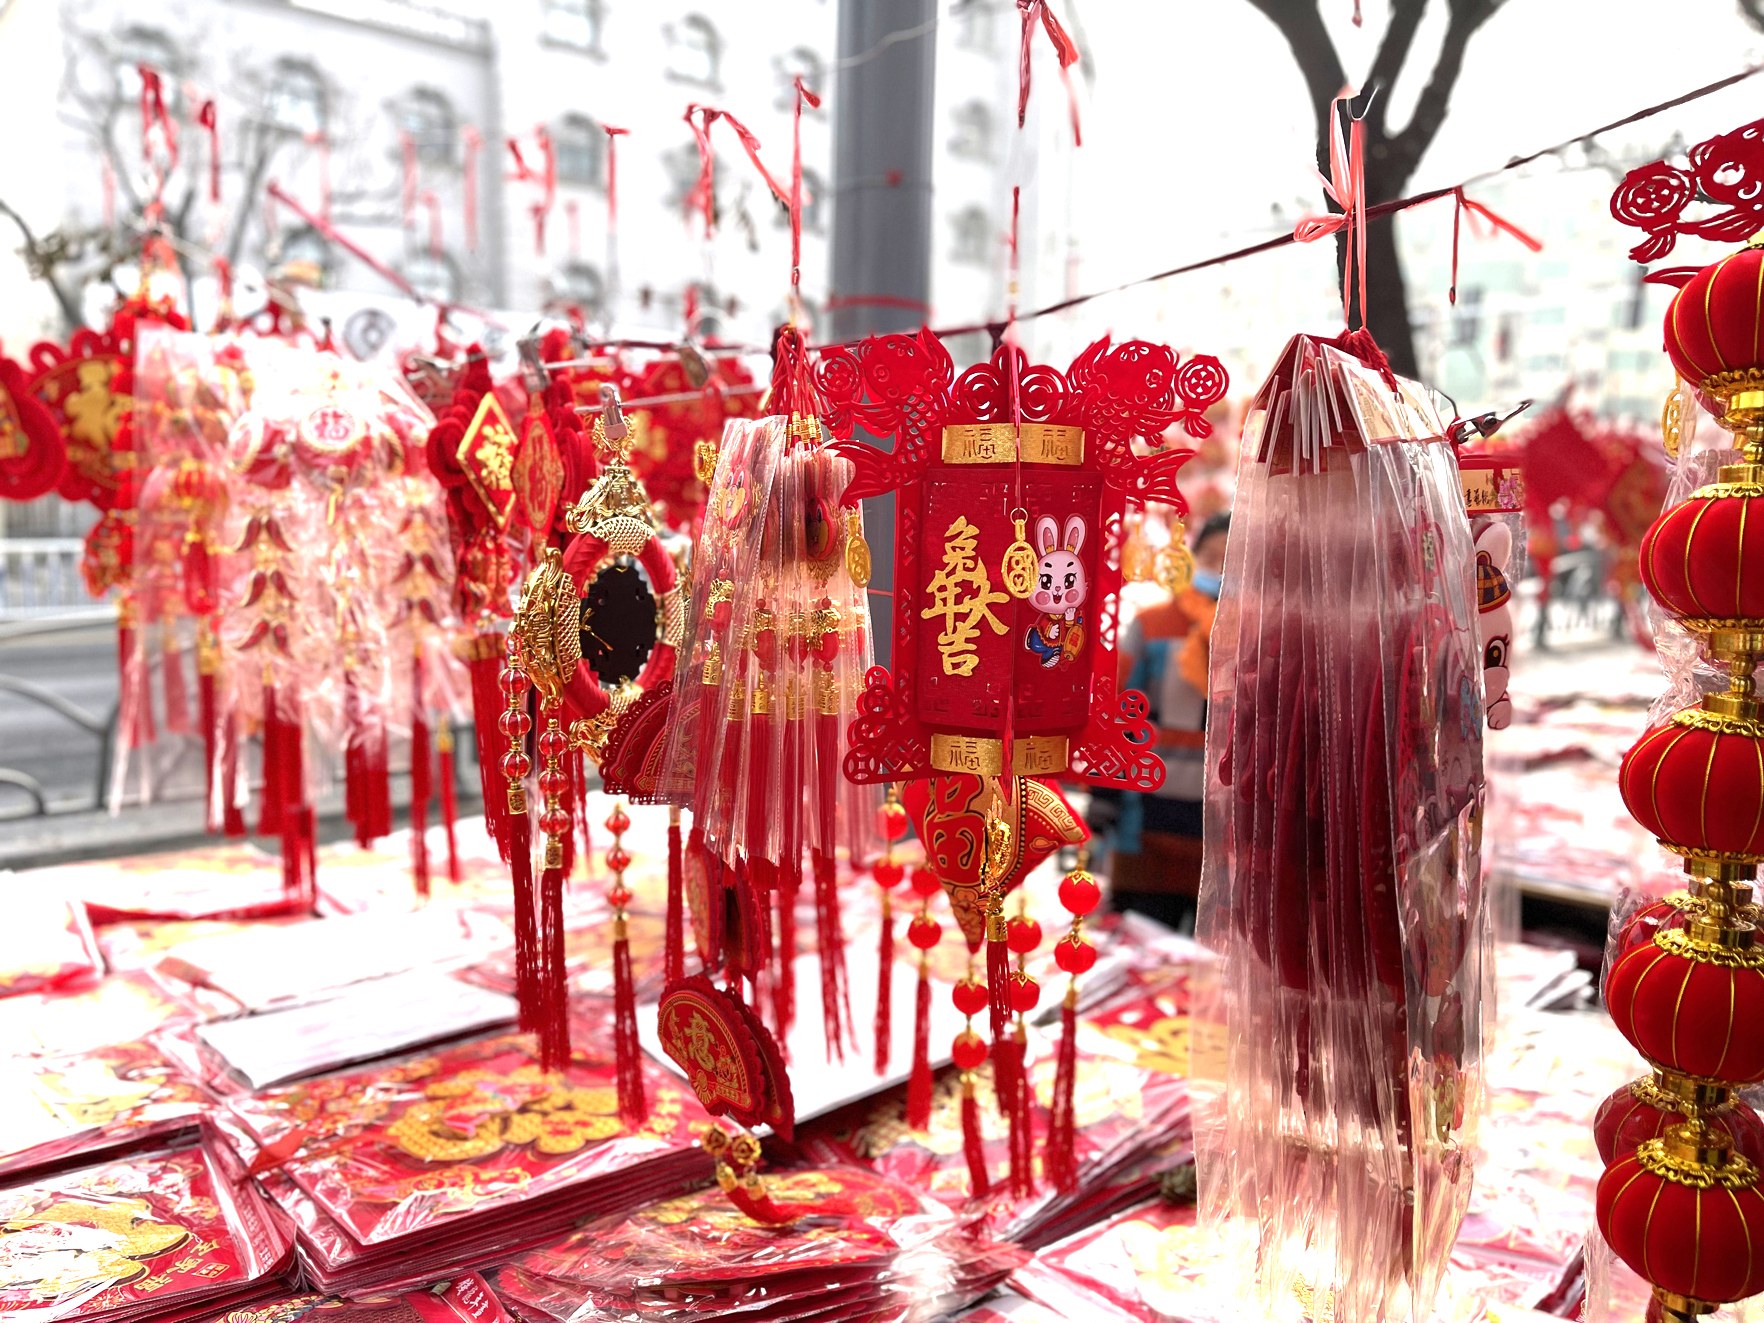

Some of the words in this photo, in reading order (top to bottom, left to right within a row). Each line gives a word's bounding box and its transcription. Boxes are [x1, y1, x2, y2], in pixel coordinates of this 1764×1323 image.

[962, 428, 996, 459] 福
[1041, 429, 1070, 460] 福
[921, 515, 1011, 677] 兔年大吉
[949, 741, 980, 770] 福
[1024, 742, 1053, 770] 福
